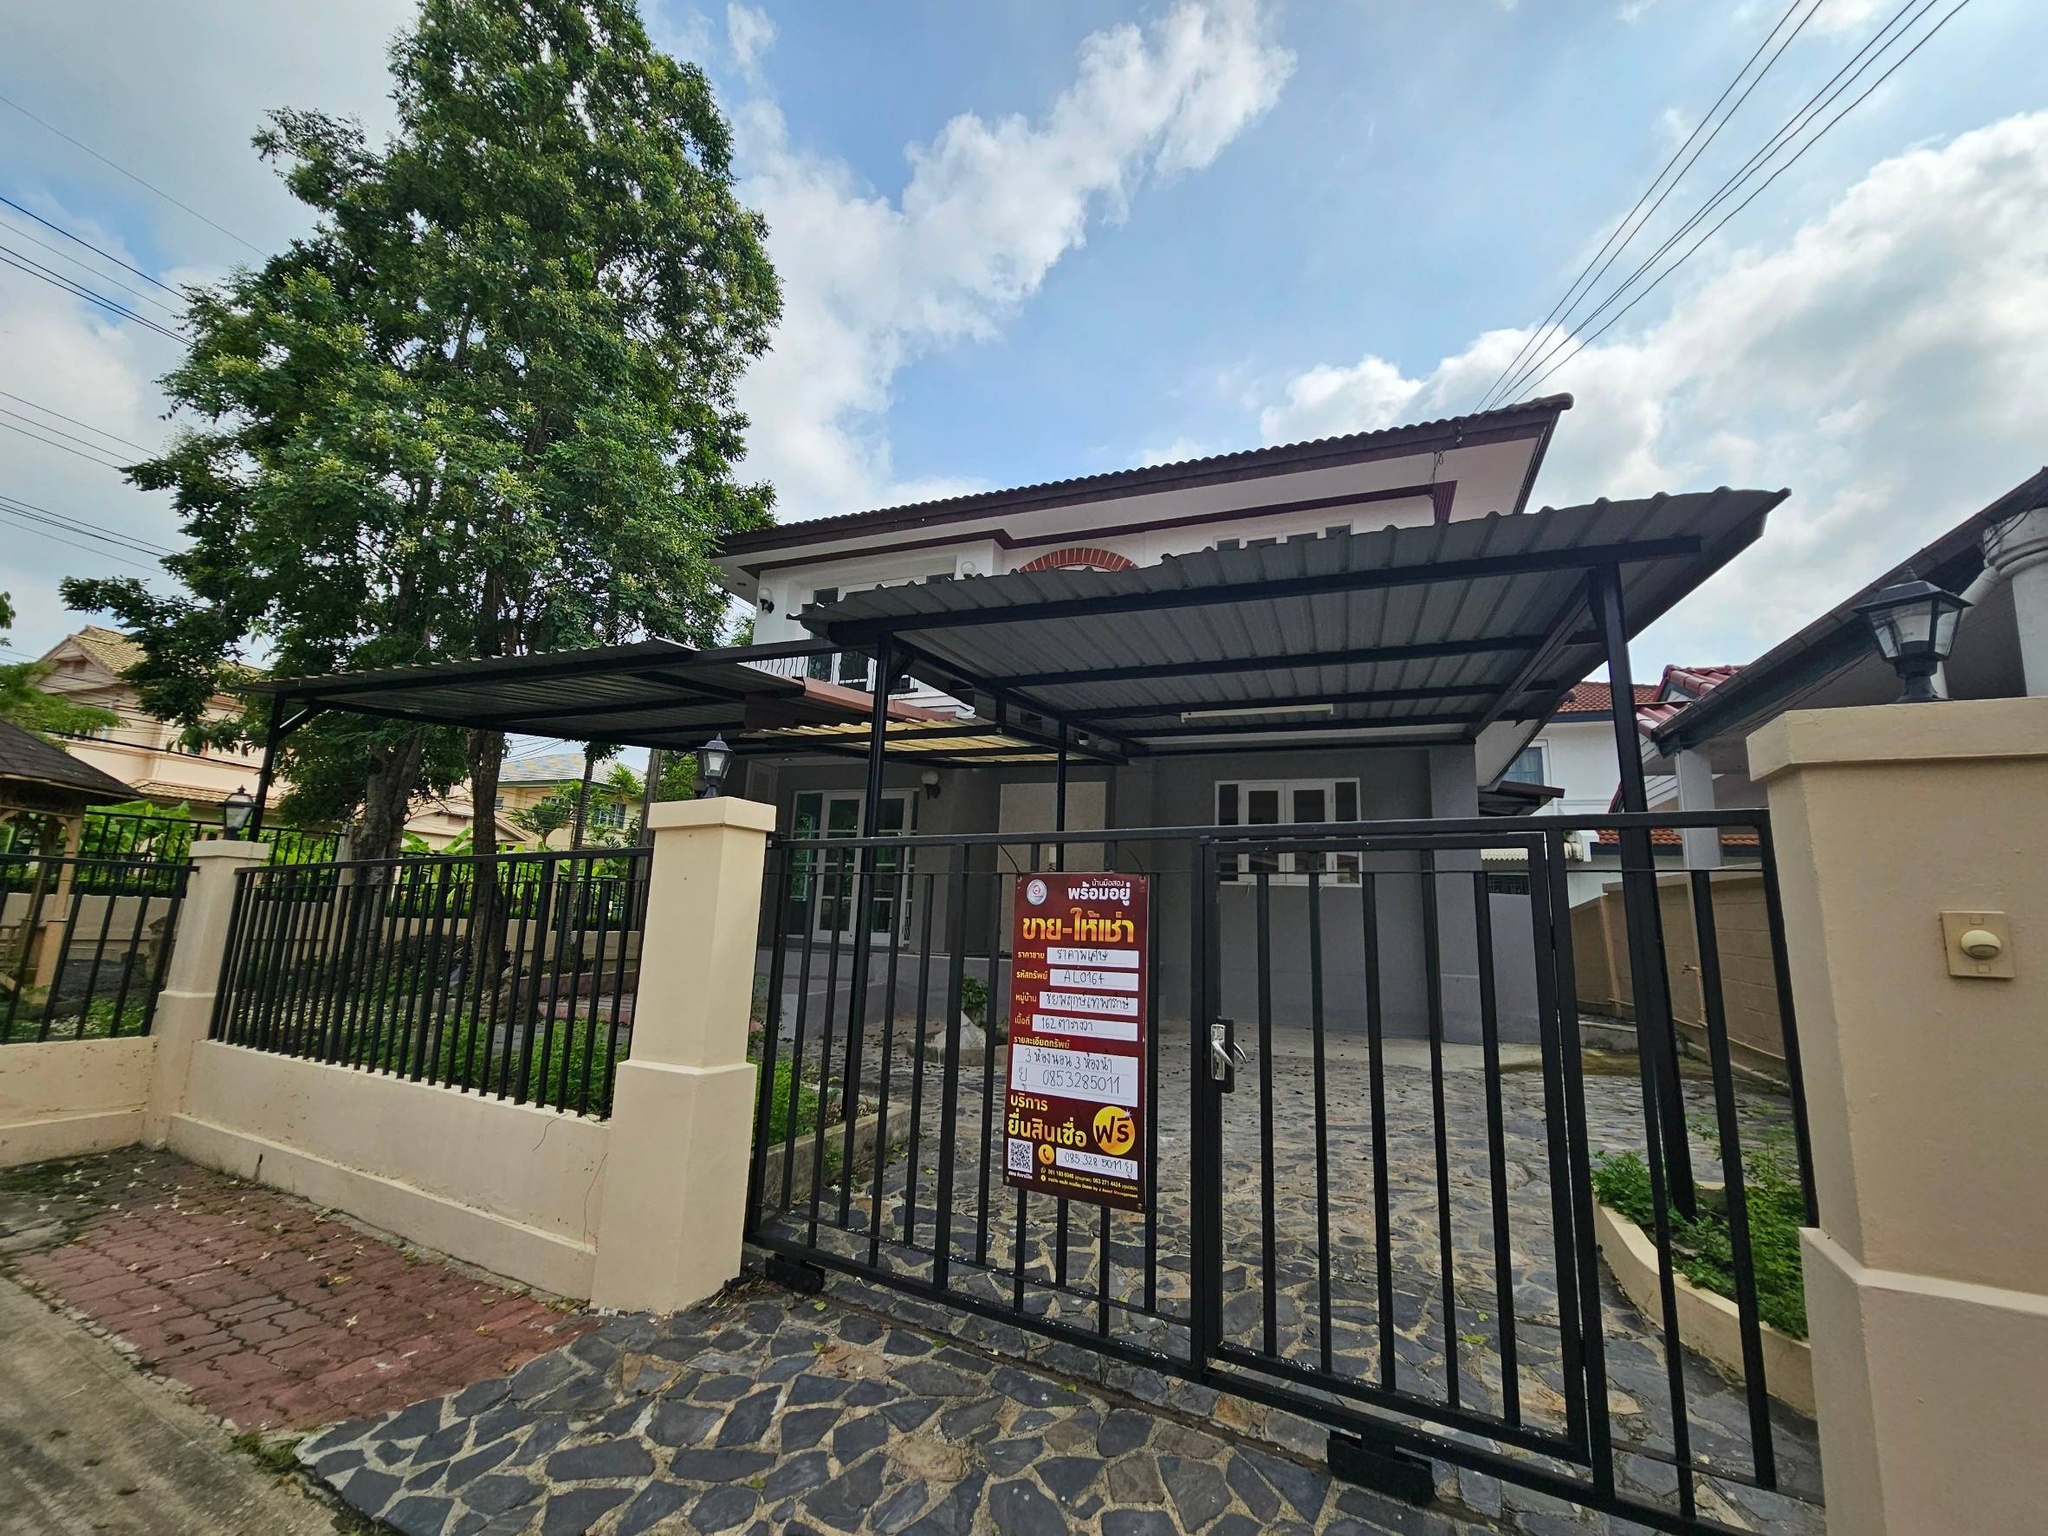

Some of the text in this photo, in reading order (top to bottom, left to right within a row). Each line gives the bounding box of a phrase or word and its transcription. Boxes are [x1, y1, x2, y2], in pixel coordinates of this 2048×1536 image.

[1091, 878, 1125, 887] บ้านมือสอง
[1067, 881, 1131, 906] พร้อมอยู่
[1022, 907, 1135, 943] ขาย-ให้เช่า
[1017, 951, 1045, 960] ราคาขาย
[1016, 969, 1048, 980] รหัสทรัพย์
[1015, 991, 1037, 1005] หมู่บ้าน
[1014, 1012, 1031, 1026] เนื้อที่
[1041, 1017, 1057, 1030] 162
[1013, 1035, 1070, 1049] รายละเอียดทรัพย์
[1025, 1047, 1032, 1063] 3
[1074, 1056, 1081, 1070] 3
[1042, 1069, 1121, 1094] 0853285011
[1010, 1093, 1048, 1112] บริการ
[1008, 1108, 1087, 1148] ยื่นสินเชื่อ
[1095, 1116, 1130, 1144] ฟรี
[1064, 1152, 1080, 1165] 085
[1082, 1154, 1098, 1167] 328
[1101, 1158, 1122, 1171] 5011
